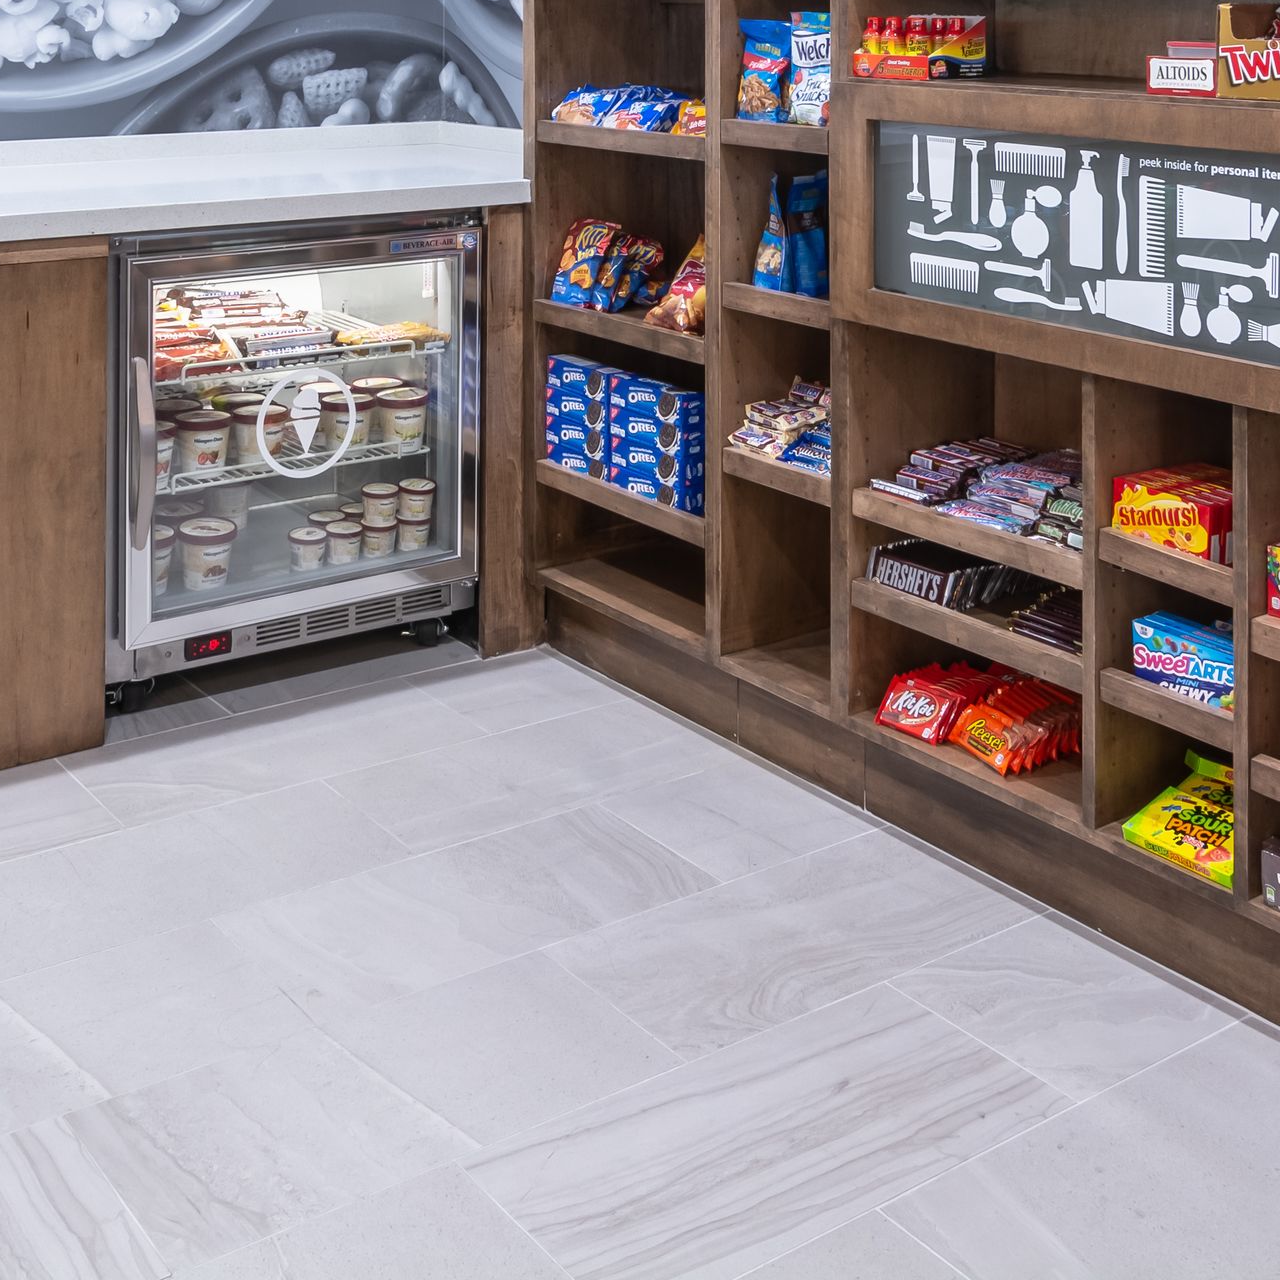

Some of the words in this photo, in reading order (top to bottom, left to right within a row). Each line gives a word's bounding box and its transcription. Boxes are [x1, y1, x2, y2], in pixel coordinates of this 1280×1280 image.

[1156, 65, 1207, 81] ALTOIDS
[1139, 158, 1162, 168] peek
[1164, 159, 1192, 171] inside
[1194, 161, 1208, 173] for
[1211, 165, 1259, 178] personal
[577, 225, 609, 249] RITZ
[563, 372, 585, 382] OREO
[629, 392, 656, 403] OREO
[561, 401, 584, 412] OREO
[629, 423, 656, 433] OREO
[561, 430, 584, 440] OREO
[562, 458, 586, 468] OREO
[629, 452, 656, 463] OREO
[628, 483, 655, 494] OREO
[1119, 504, 1198, 527] Starburst
[877, 557, 940, 601] HERSHEY'S
[1176, 678, 1199, 687] MINI
[967, 719, 1005, 751] Reese's
[1179, 809, 1233, 835] SOUR
[1167, 817, 1226, 847] PATCH
